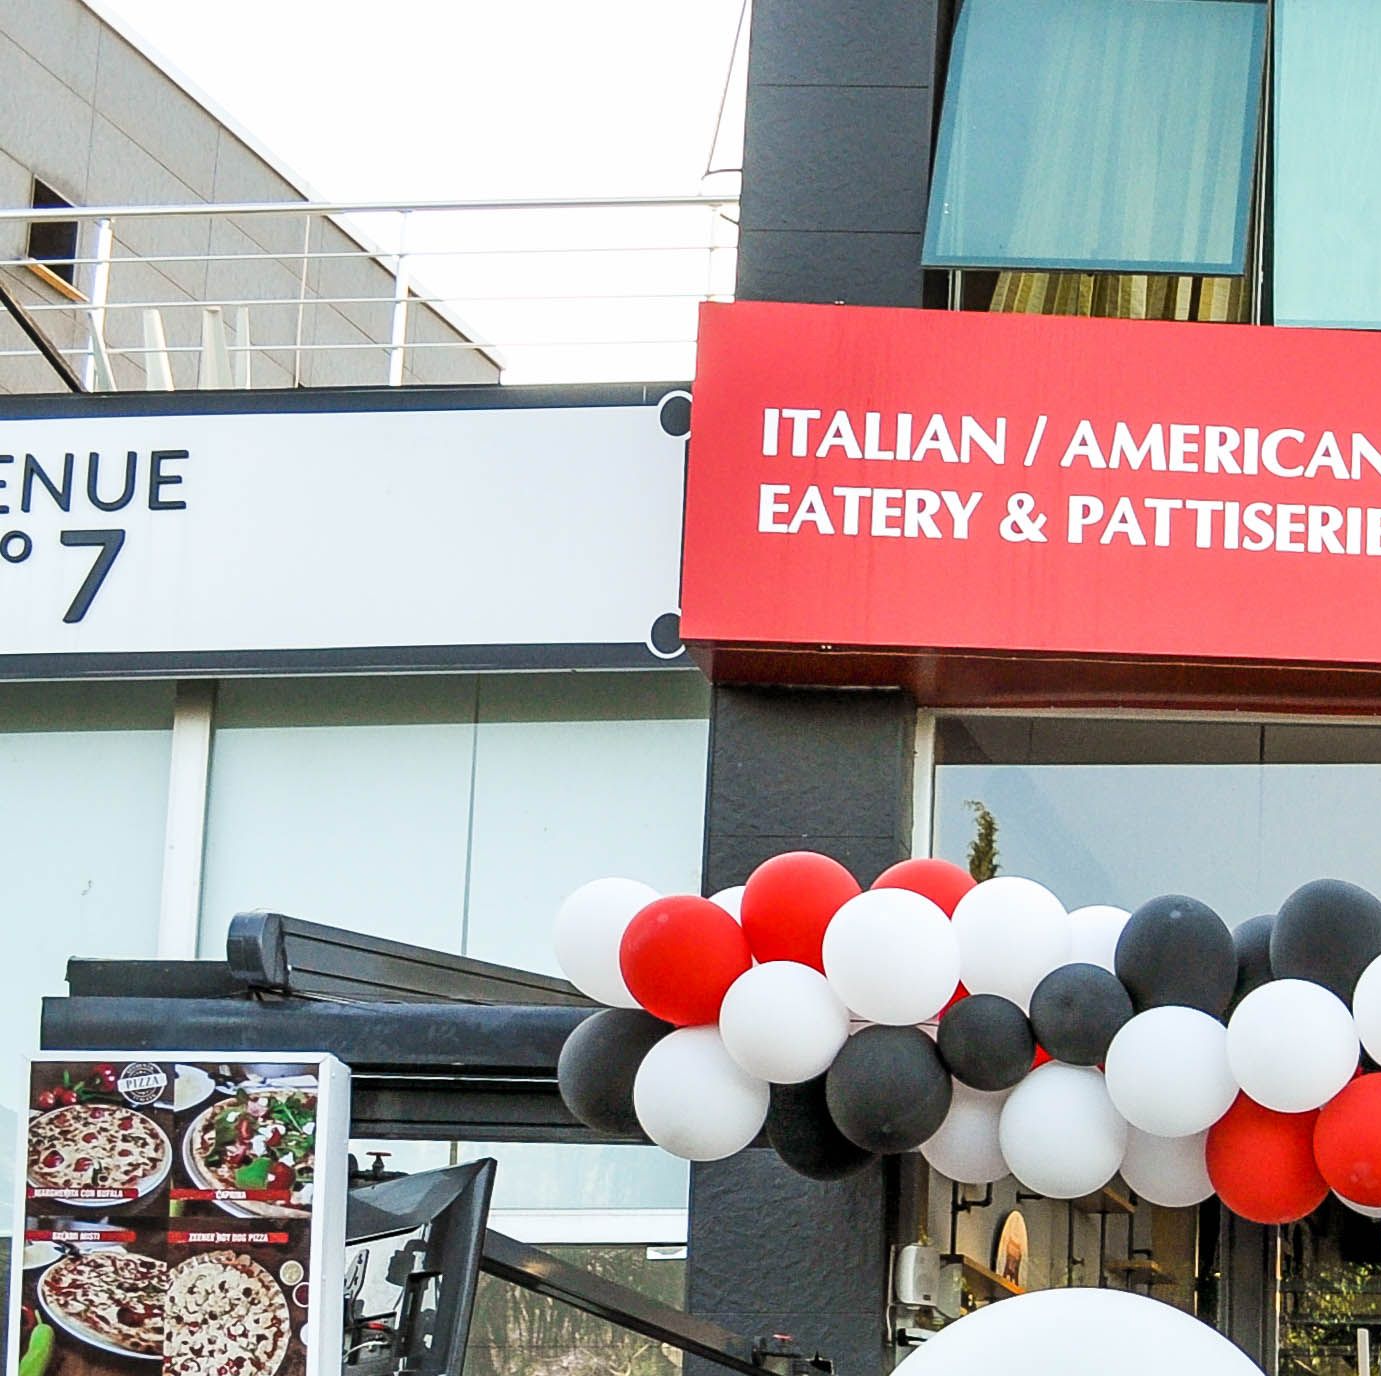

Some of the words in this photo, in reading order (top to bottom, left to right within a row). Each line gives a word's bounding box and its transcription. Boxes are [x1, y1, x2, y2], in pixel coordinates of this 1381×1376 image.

[762, 408, 1006, 465] ITALIAN
[0, 449, 190, 513] NUE
[757, 484, 984, 539] EATERY
[999, 492, 1048, 543] &
[126, 1075, 159, 1089] PIZZA
